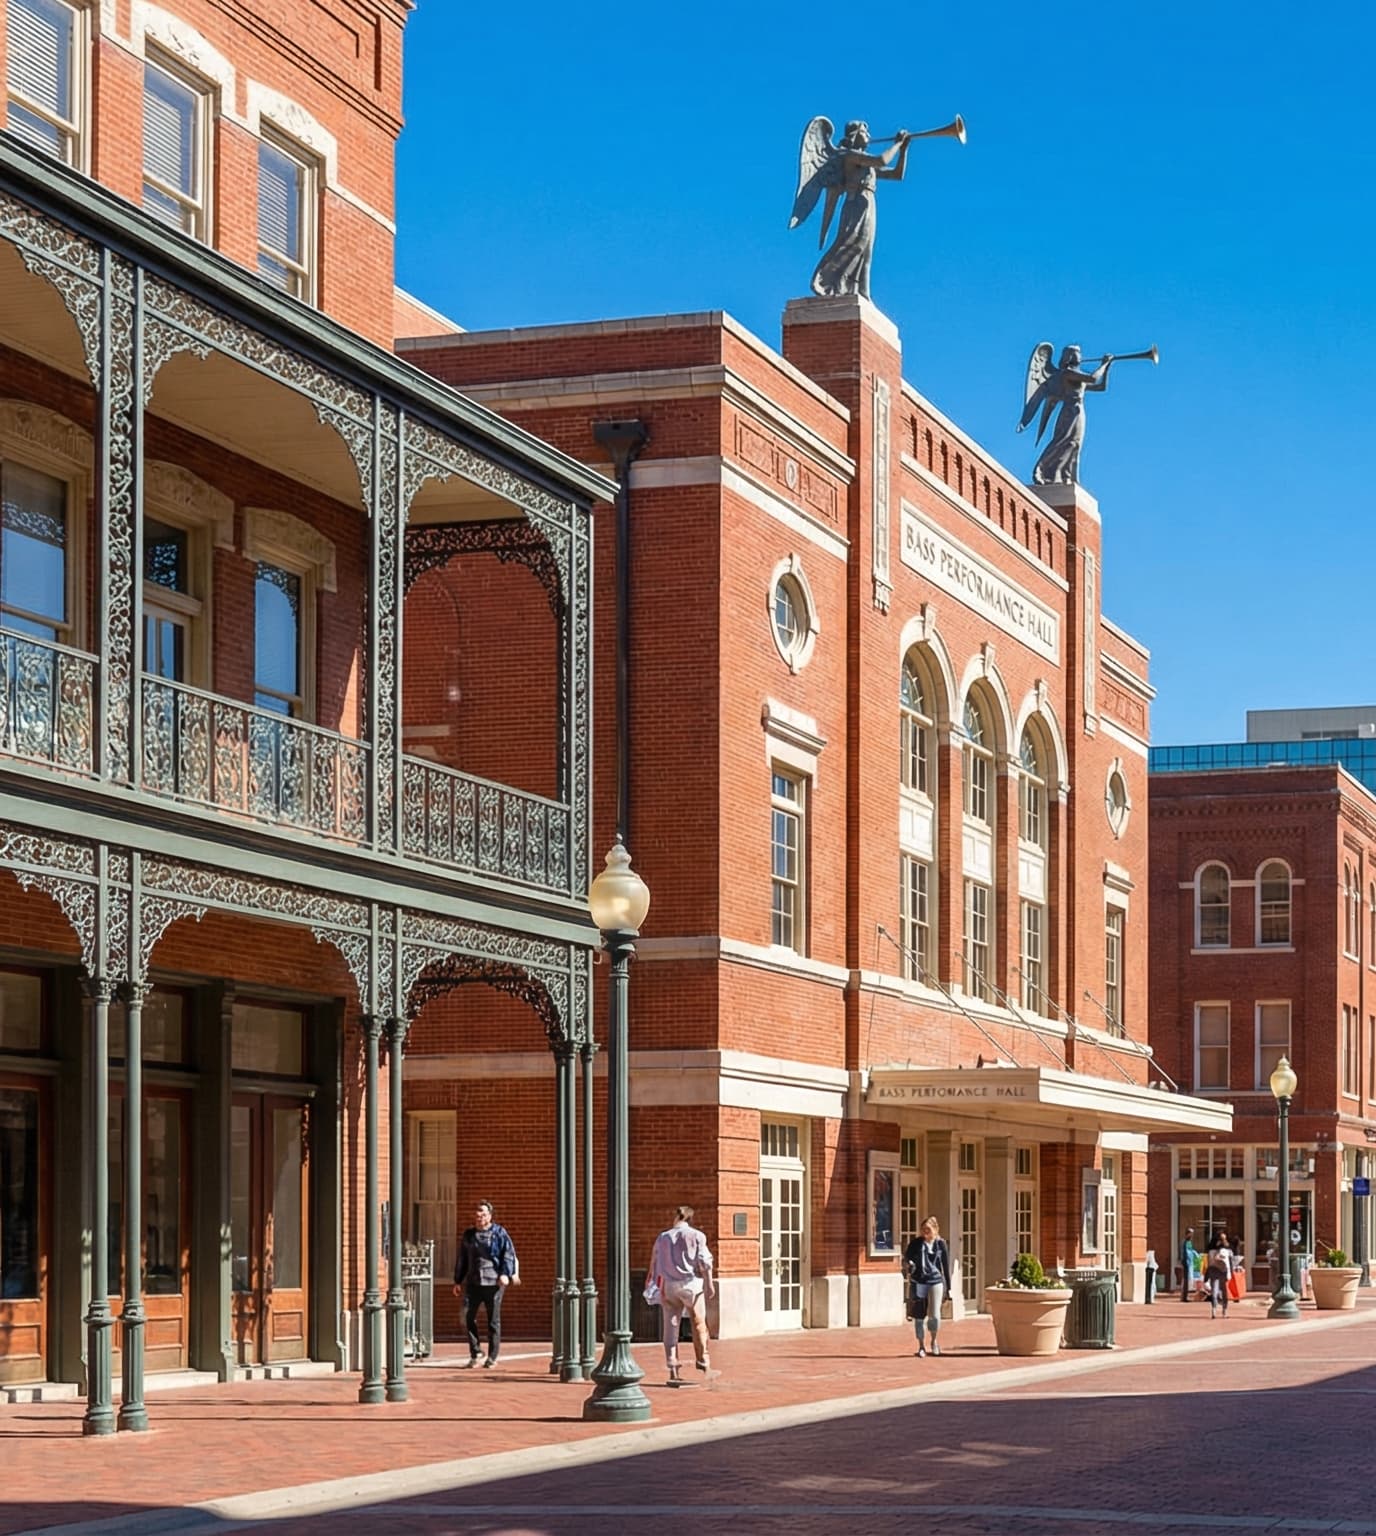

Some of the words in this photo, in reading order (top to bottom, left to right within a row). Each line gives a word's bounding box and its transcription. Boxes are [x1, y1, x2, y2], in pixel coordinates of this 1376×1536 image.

[906, 523, 935, 565] BASS
[940, 549, 1024, 627] PERFORMANCE
[1027, 610, 1053, 647] HALL
[996, 1086, 1026, 1097] HALL
